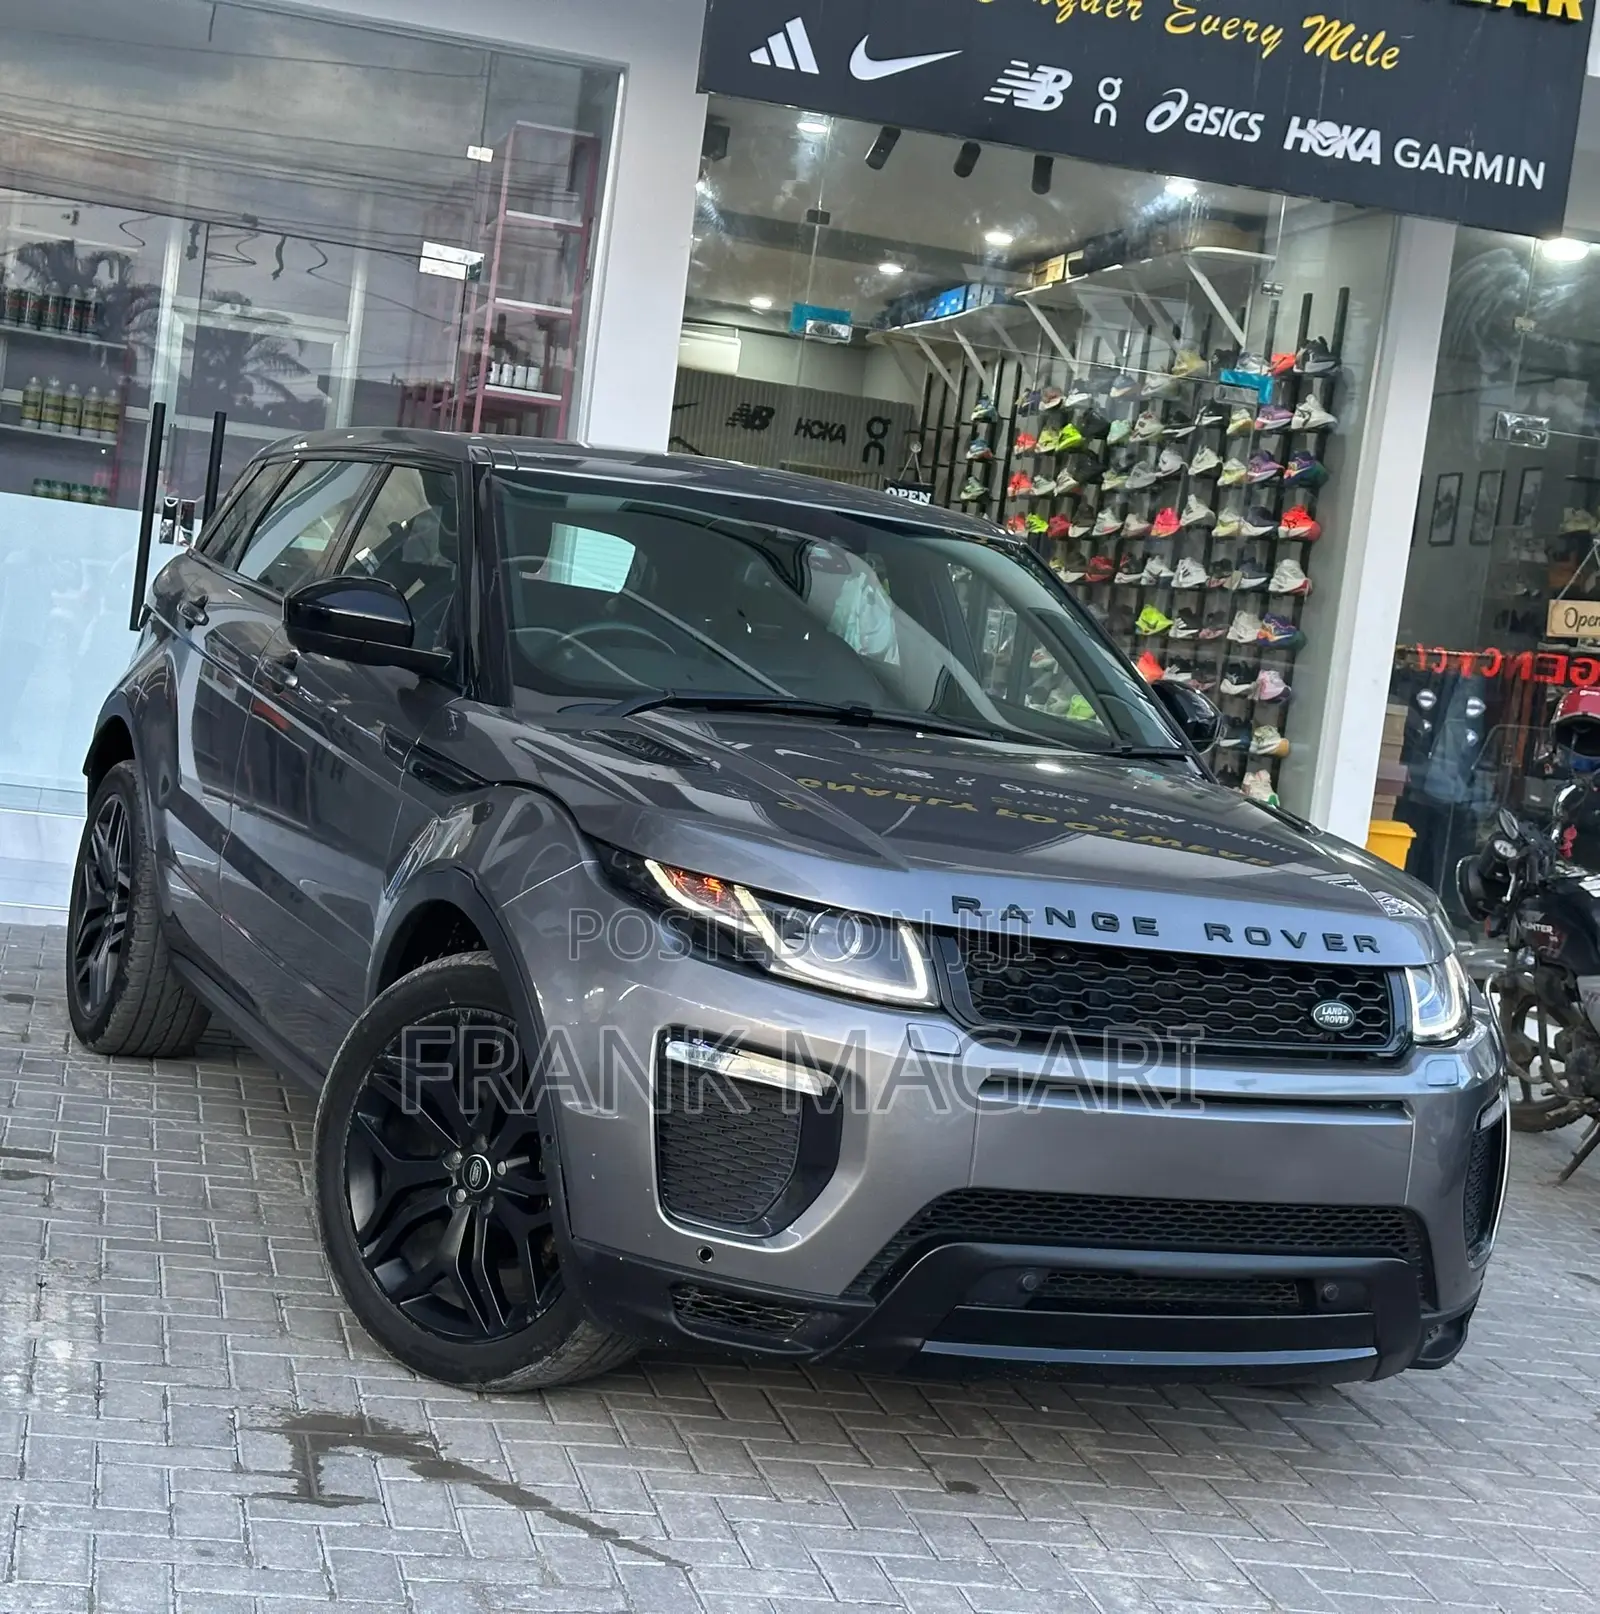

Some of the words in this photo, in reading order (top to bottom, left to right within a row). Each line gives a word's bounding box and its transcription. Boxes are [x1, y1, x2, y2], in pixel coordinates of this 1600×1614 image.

[1164, 0, 1284, 59] Every
[1302, 14, 1401, 70] Mile
[1283, 116, 1381, 166] HOKA
[1394, 137, 1546, 190] GARMIN
[794, 417, 847, 444] HOKA
[885, 486, 931, 504] OPEN
[951, 895, 1160, 936] RANGE
[1204, 921, 1381, 954] ROVER
[1322, 1006, 1342, 1015] LAND
[1323, 1015, 1349, 1024] ROVER
